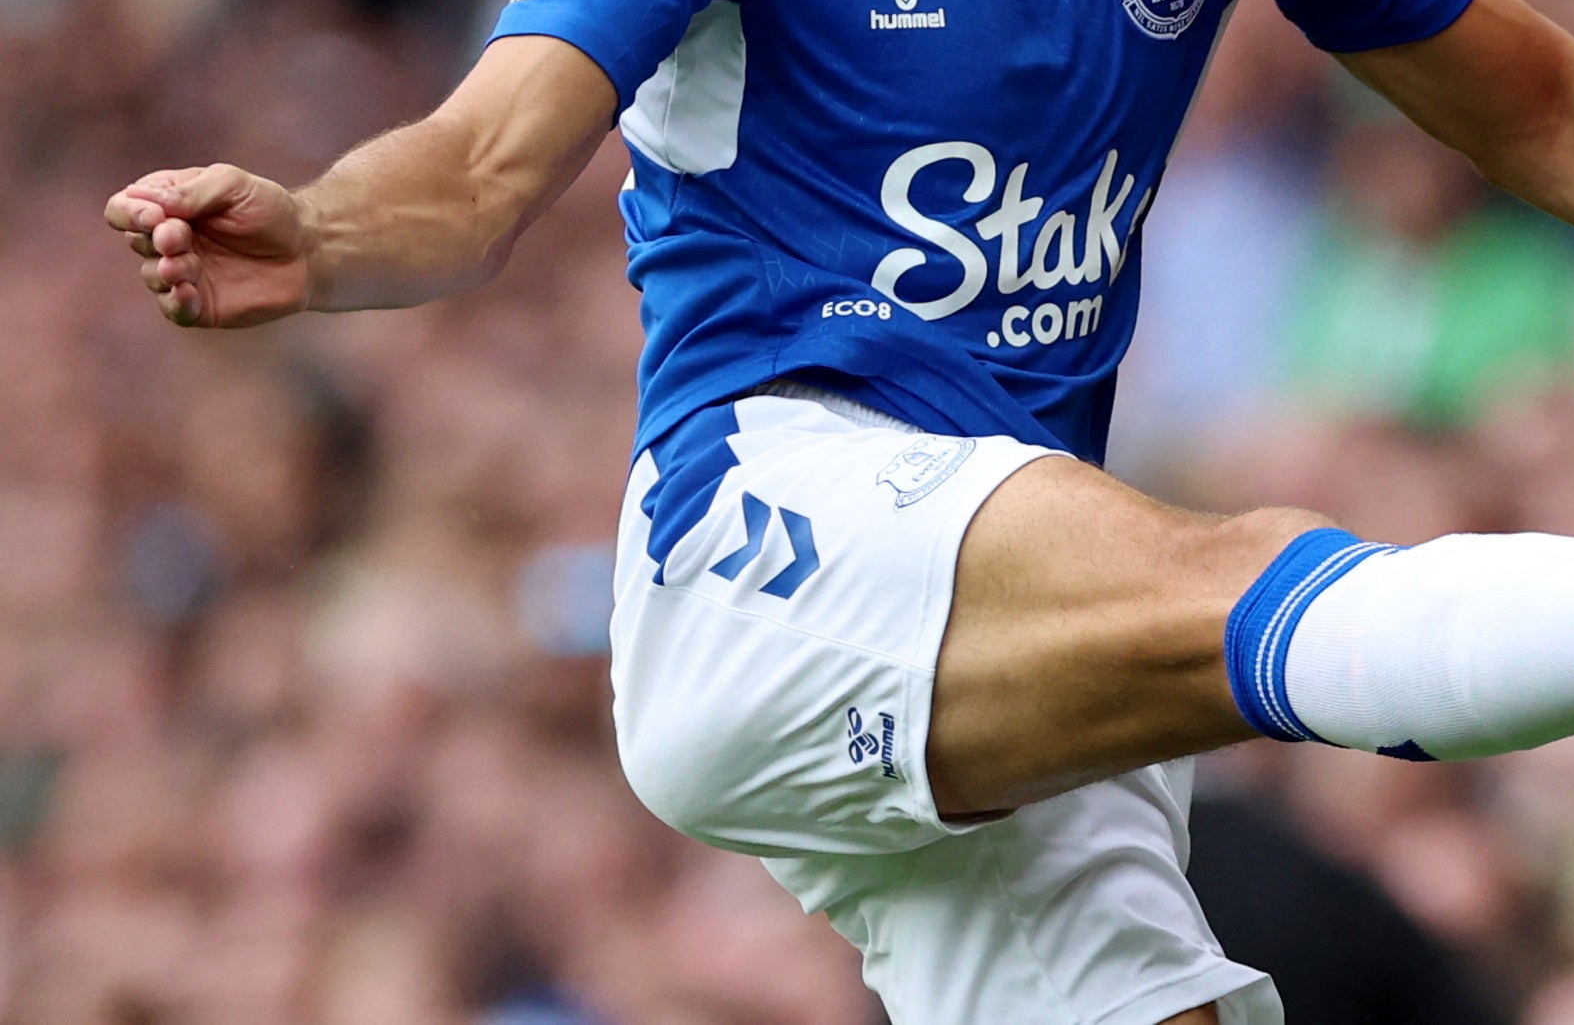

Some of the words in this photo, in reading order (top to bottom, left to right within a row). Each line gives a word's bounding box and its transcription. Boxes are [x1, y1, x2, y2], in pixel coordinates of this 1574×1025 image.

[870, 7, 946, 30] hummel
[870, 140, 1152, 321] Stak
[821, 299, 893, 321] ECO8
[986, 294, 1104, 349] .com
[878, 711, 899, 780] hummel
